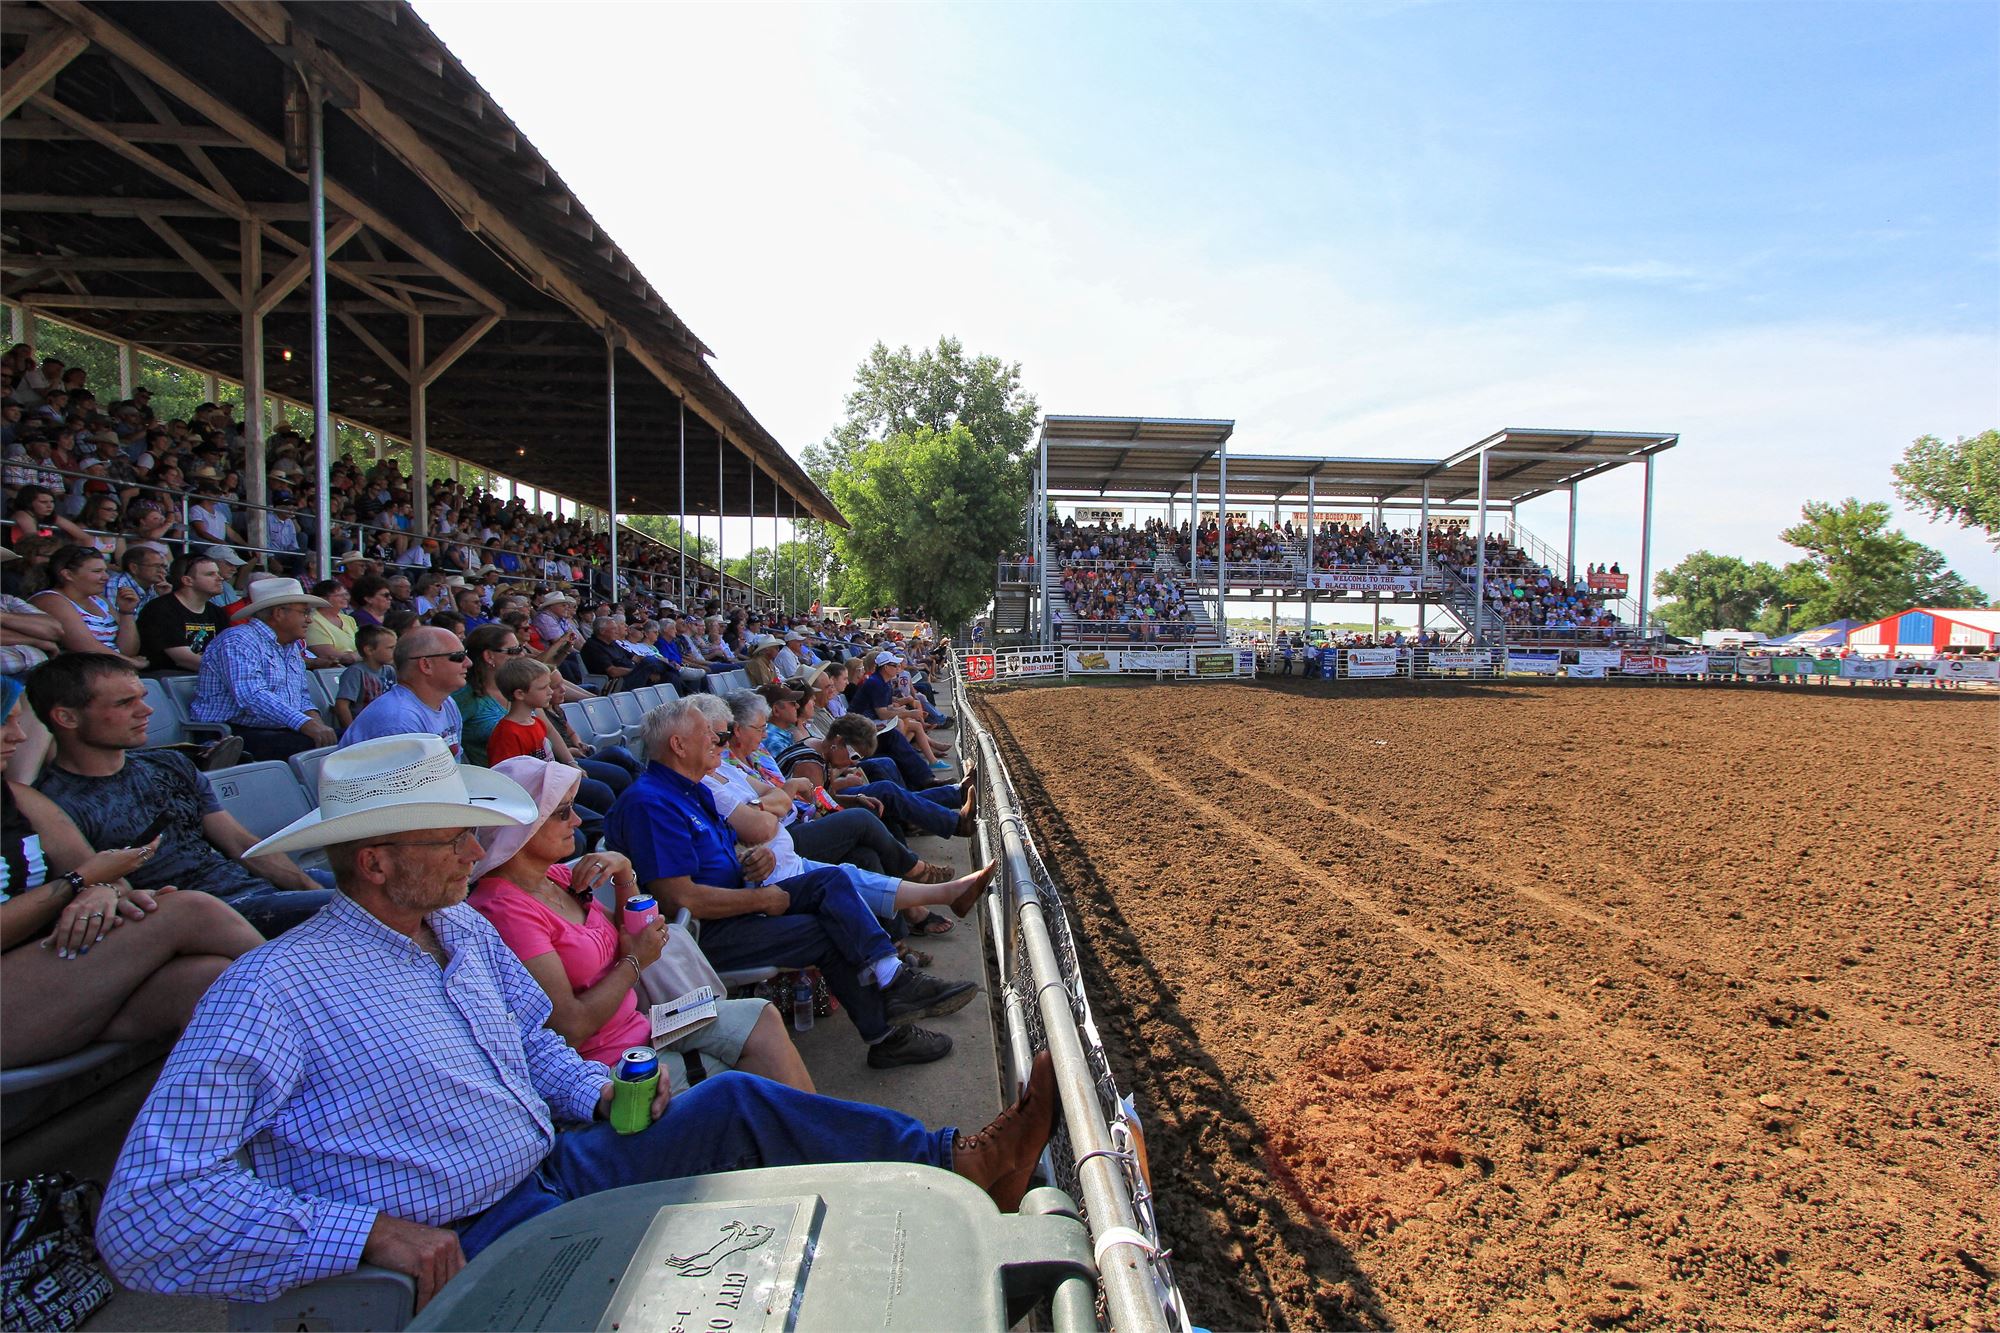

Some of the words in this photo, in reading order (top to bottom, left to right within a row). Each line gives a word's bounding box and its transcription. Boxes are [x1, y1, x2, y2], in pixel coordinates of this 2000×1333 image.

[1293, 512, 1324, 520] WELCME
[1325, 513, 1344, 521] RODEO
[1345, 513, 1362, 521] FANS
[1333, 575, 1367, 583] WELCOME
[1325, 582, 1348, 590] BLACK
[1373, 583, 1405, 591] ROUNDUP
[1021, 655, 1054, 665] RAM
[221, 786, 234, 797] 21
[714, 1272, 749, 1310] CITY
